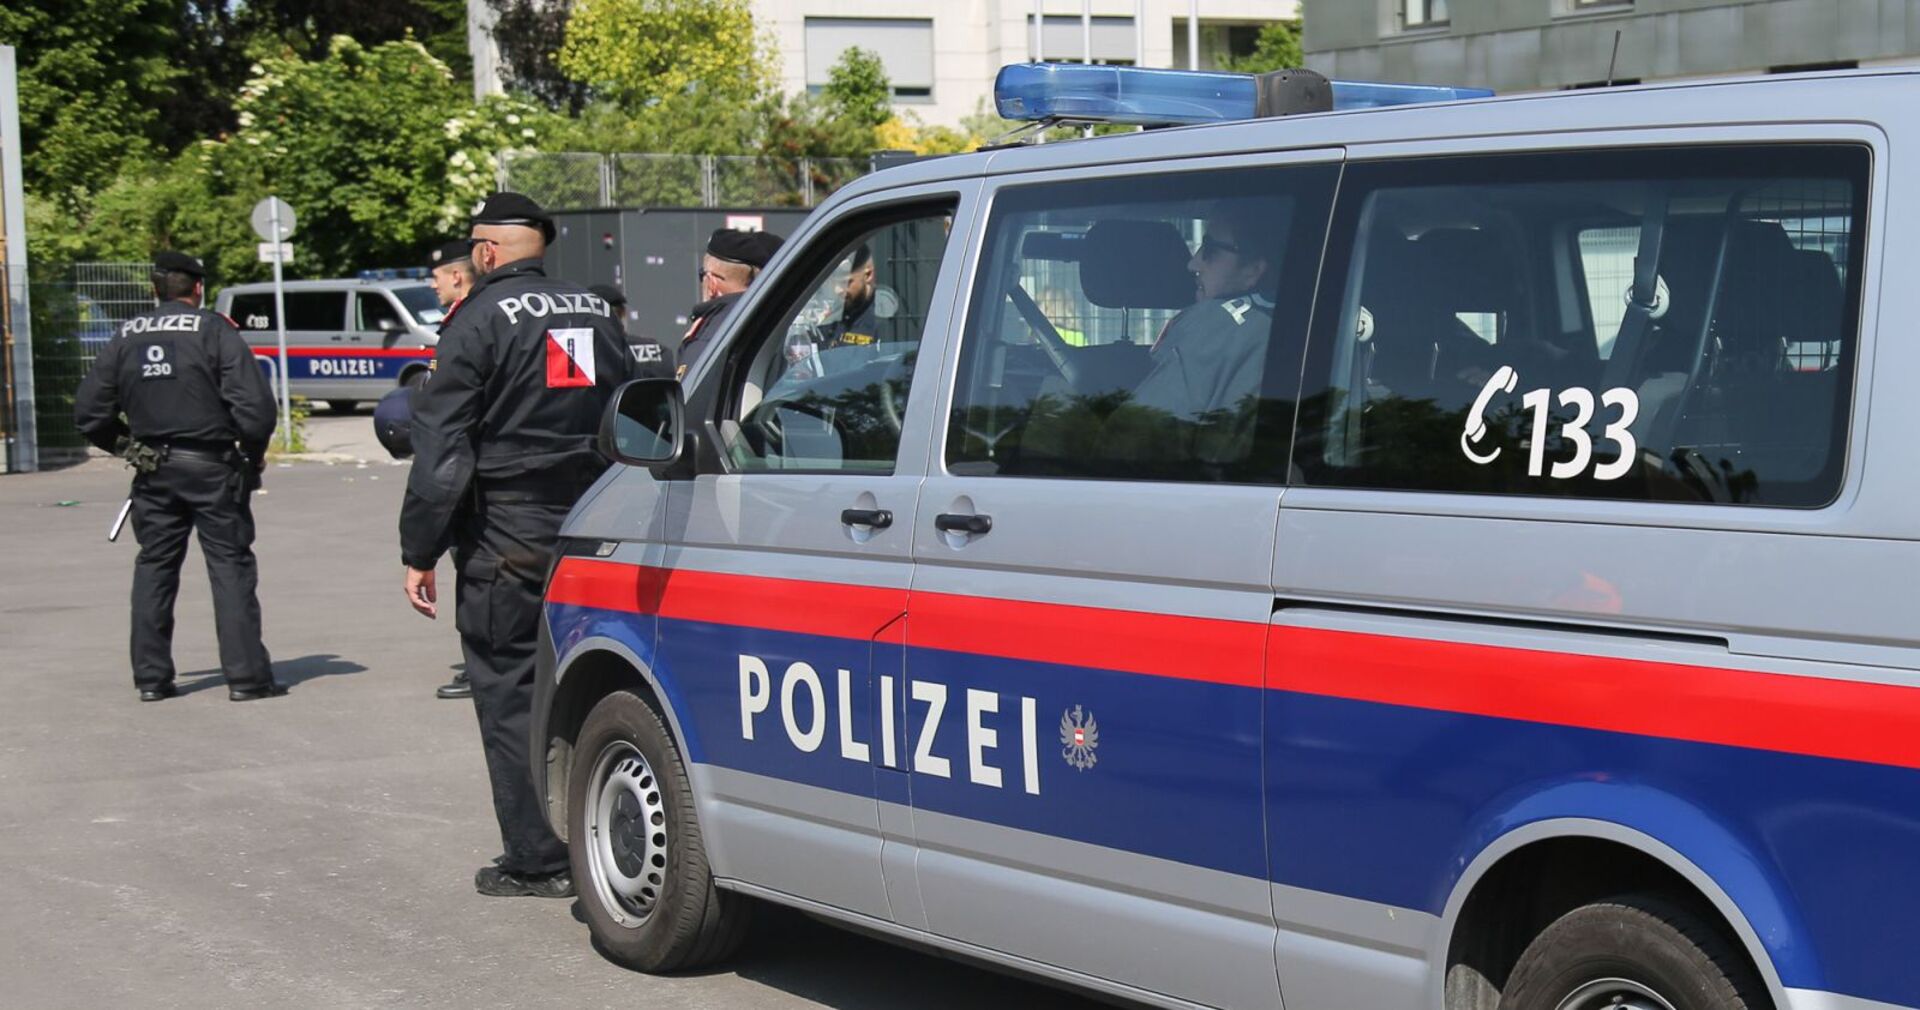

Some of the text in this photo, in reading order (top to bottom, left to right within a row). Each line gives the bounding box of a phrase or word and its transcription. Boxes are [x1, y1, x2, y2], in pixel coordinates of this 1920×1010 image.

[498, 292, 610, 325] POLIZEI
[121, 314, 202, 338] POLIZEI
[628, 344, 662, 363] IZEI
[142, 363, 172, 377] 230
[309, 359, 375, 375] POLIZEI
[1522, 386, 1639, 480] 133
[738, 654, 1040, 795] POLIZEI
